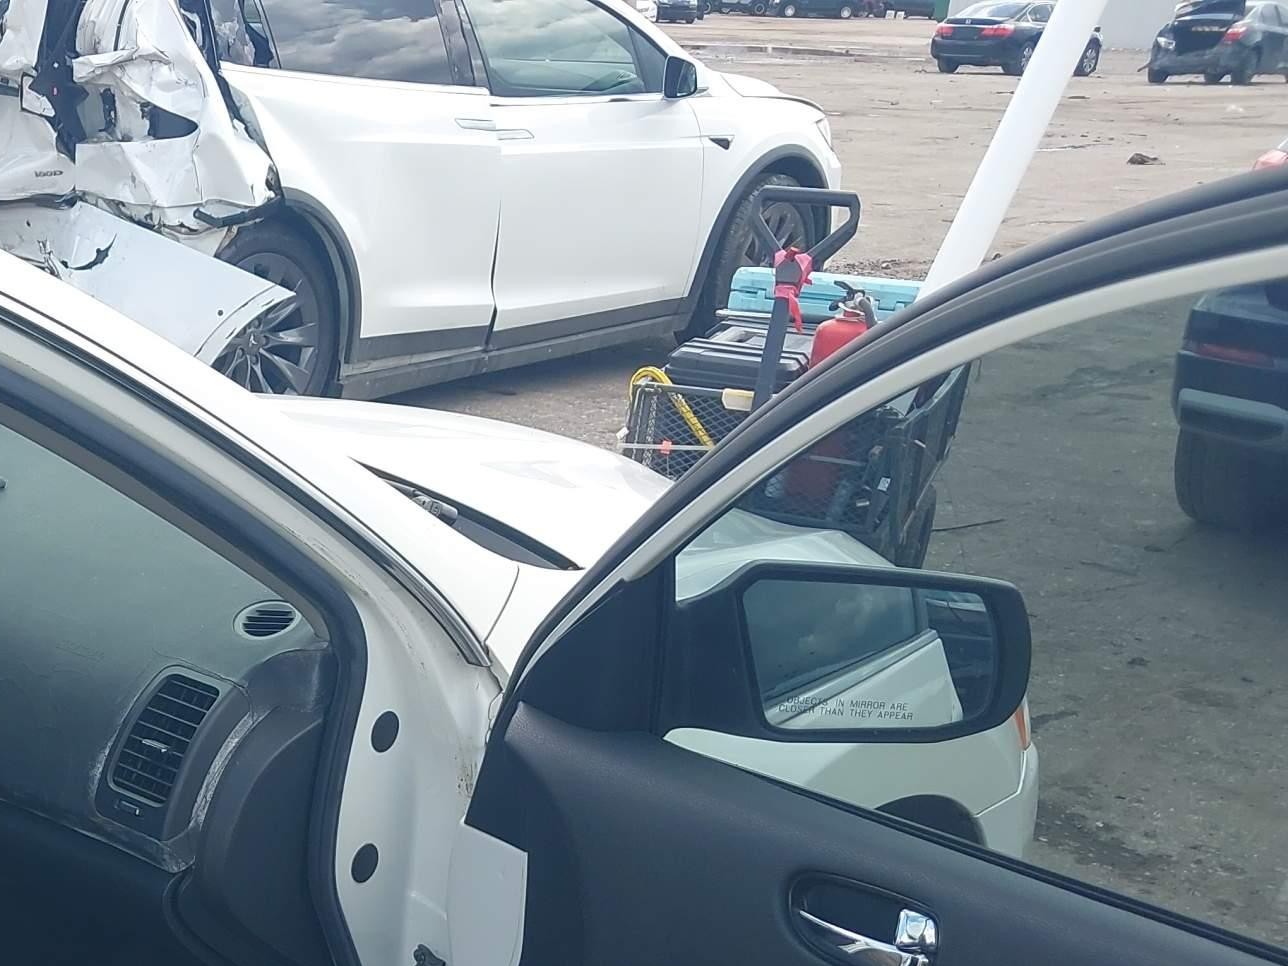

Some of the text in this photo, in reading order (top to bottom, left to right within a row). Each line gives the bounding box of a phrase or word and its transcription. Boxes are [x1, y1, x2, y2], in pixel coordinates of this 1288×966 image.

[786, 696, 910, 711] OBJECTS IN MIRROR ARE
[778, 704, 914, 721] CLOSER THAN THEY APPEAR
